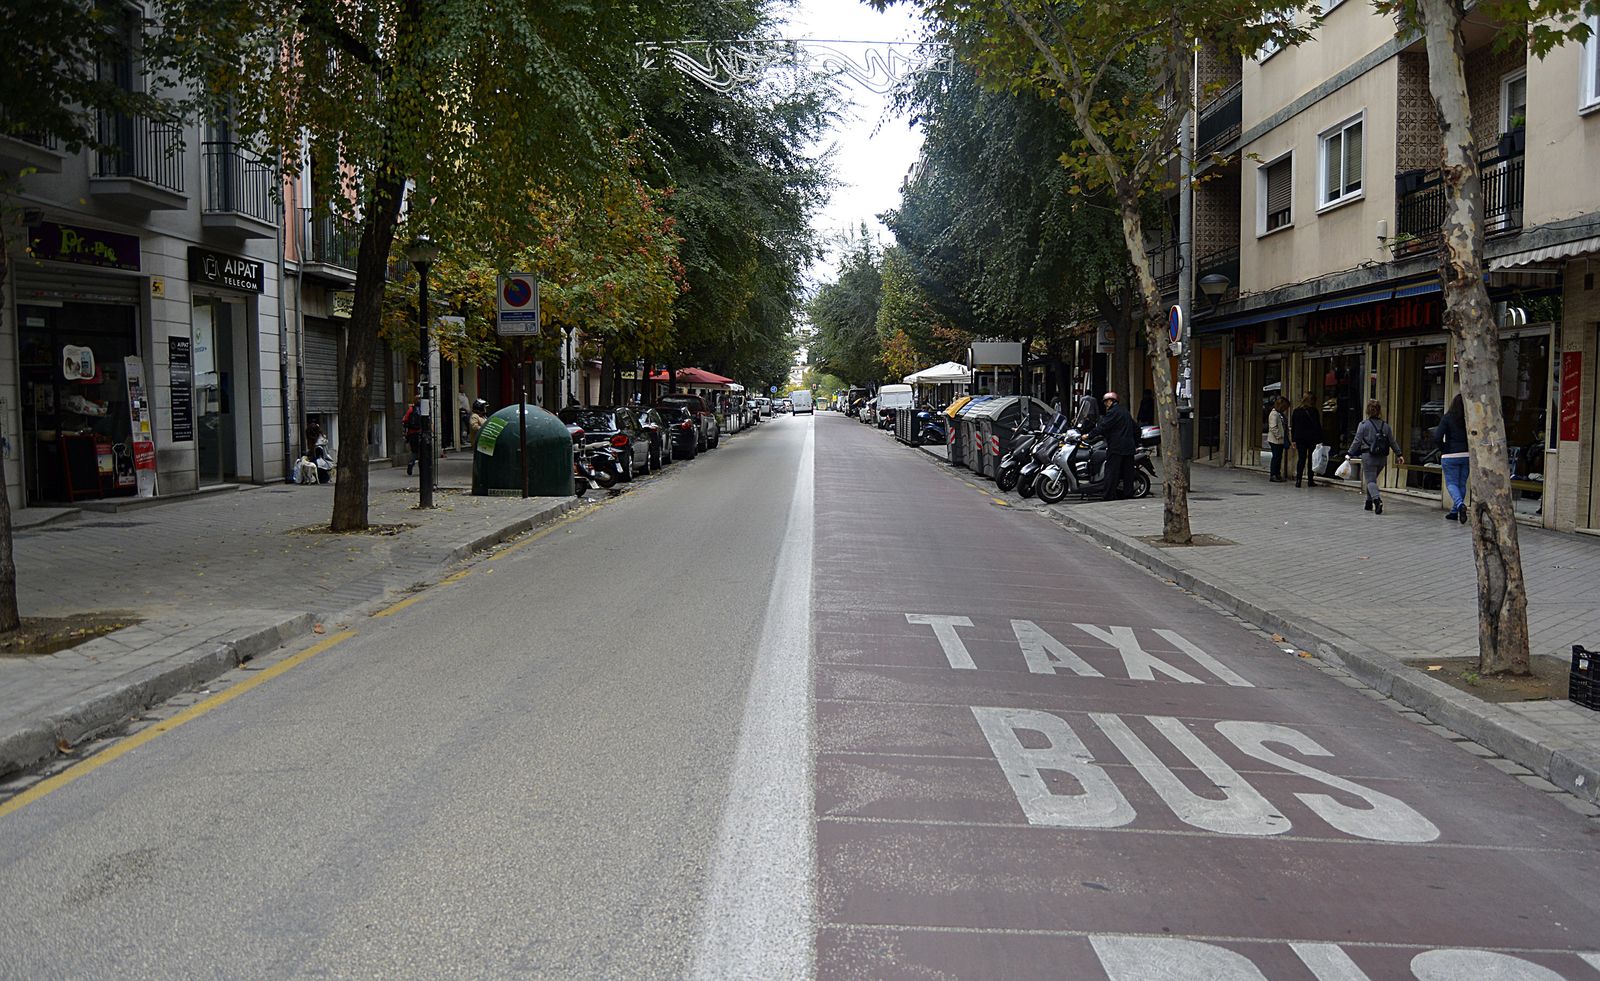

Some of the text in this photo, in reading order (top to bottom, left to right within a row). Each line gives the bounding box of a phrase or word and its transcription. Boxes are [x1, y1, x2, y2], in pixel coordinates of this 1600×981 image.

[223, 276, 258, 290] TELECOM
[224, 258, 258, 279] AIPAT
[904, 612, 1256, 688] TAXI
[970, 705, 1442, 844] BUS
